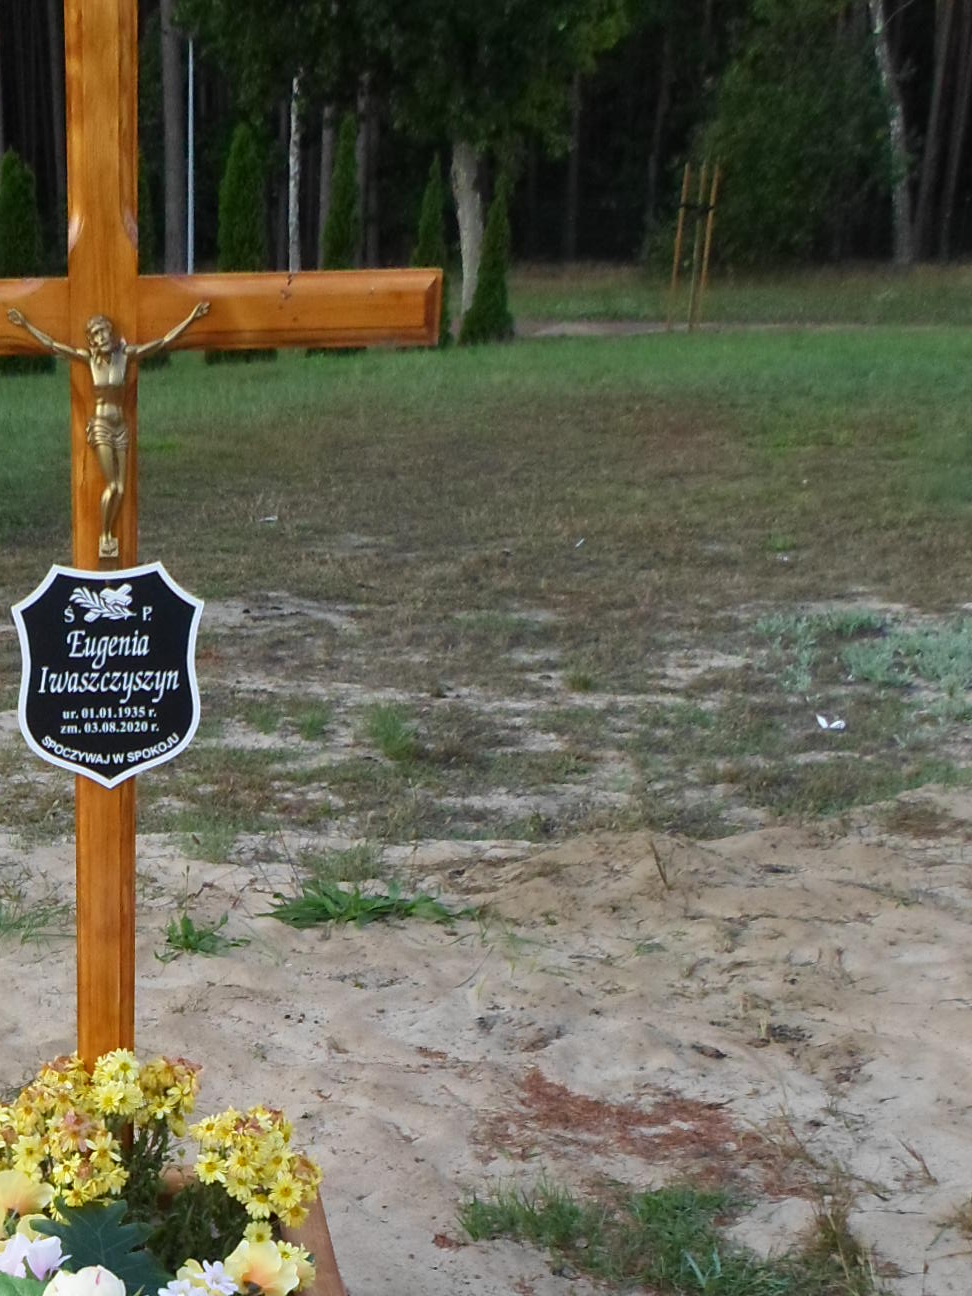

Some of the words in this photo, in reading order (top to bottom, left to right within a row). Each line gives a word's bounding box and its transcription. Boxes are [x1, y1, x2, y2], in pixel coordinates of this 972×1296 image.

[66, 629, 150, 670] Eugenia
[38, 666, 180, 704] Iwaszczyszyn
[60, 725, 81, 734] zm.
[84, 721, 148, 733] 03.08.2020
[150, 723, 160, 732] r.
[62, 710, 79, 720] ur.
[81, 706, 146, 719] 01.01.1935
[148, 708, 157, 718] r.
[41, 734, 111, 765] SPOCZYWAJ
[112, 753, 125, 764] W
[126, 732, 180, 763] SPOKOJU
